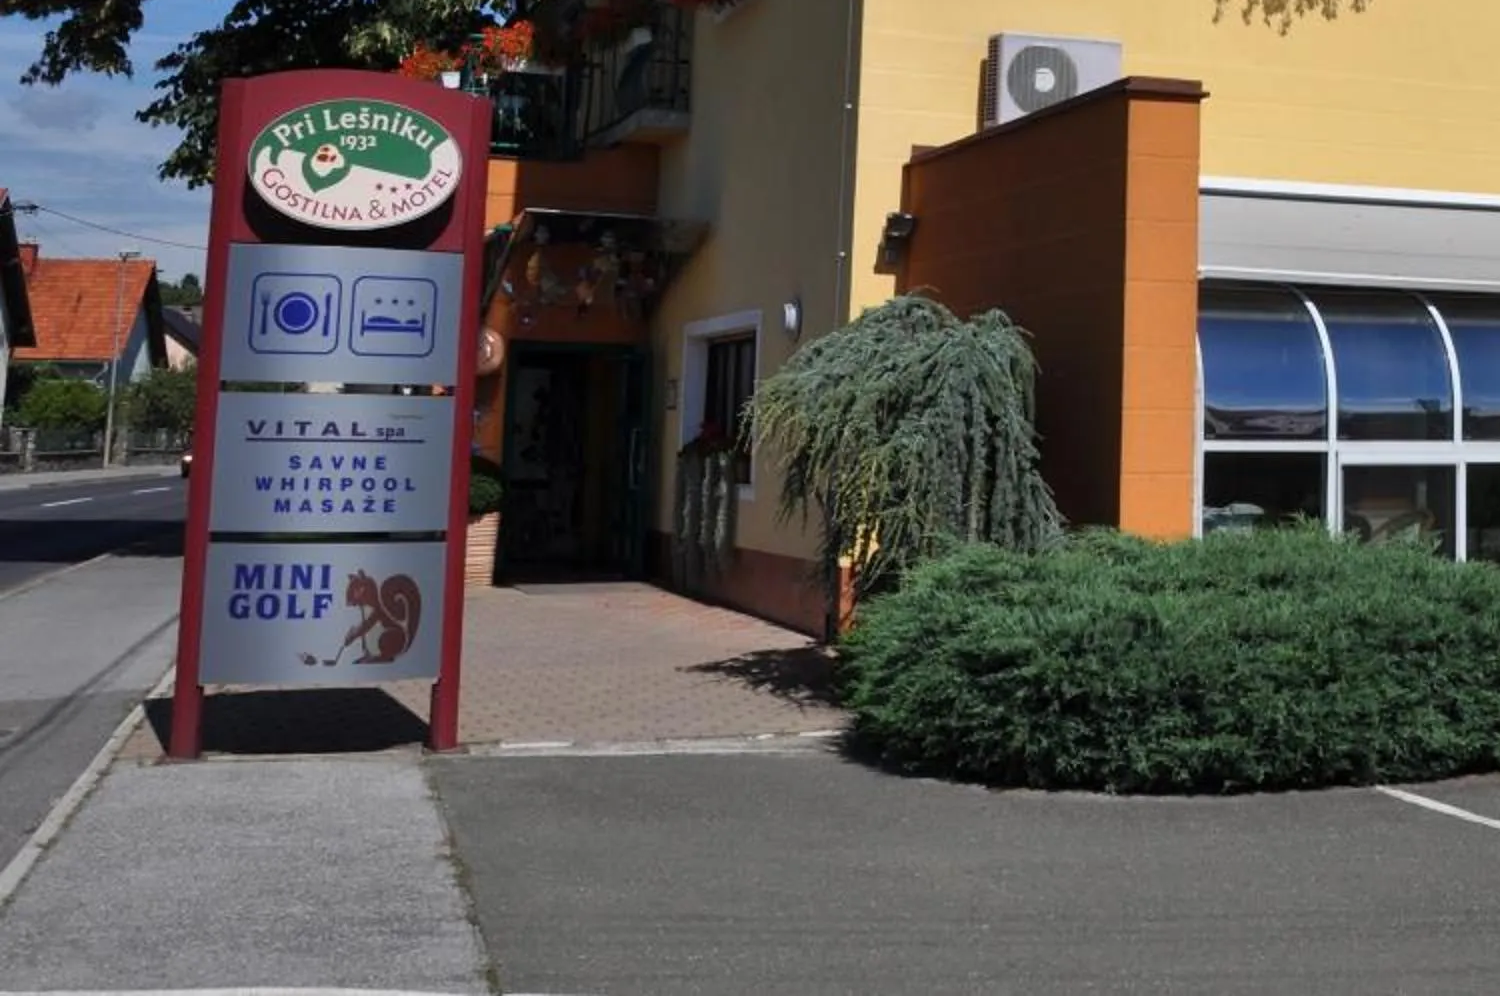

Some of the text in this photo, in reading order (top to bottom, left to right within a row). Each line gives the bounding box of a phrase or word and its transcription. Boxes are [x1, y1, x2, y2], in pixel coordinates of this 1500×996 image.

[271, 107, 435, 150] Pri Lešniku
[340, 135, 377, 151] 1932
[262, 168, 453, 221] GOSTILNA & MOTEL
[248, 420, 405, 441] VITAL spa
[289, 455, 387, 471] SAVNE
[255, 477, 416, 492] WHIRPOOL
[273, 495, 396, 514] MASAŽE
[234, 564, 332, 590] MINI
[228, 594, 333, 620] GOLF
